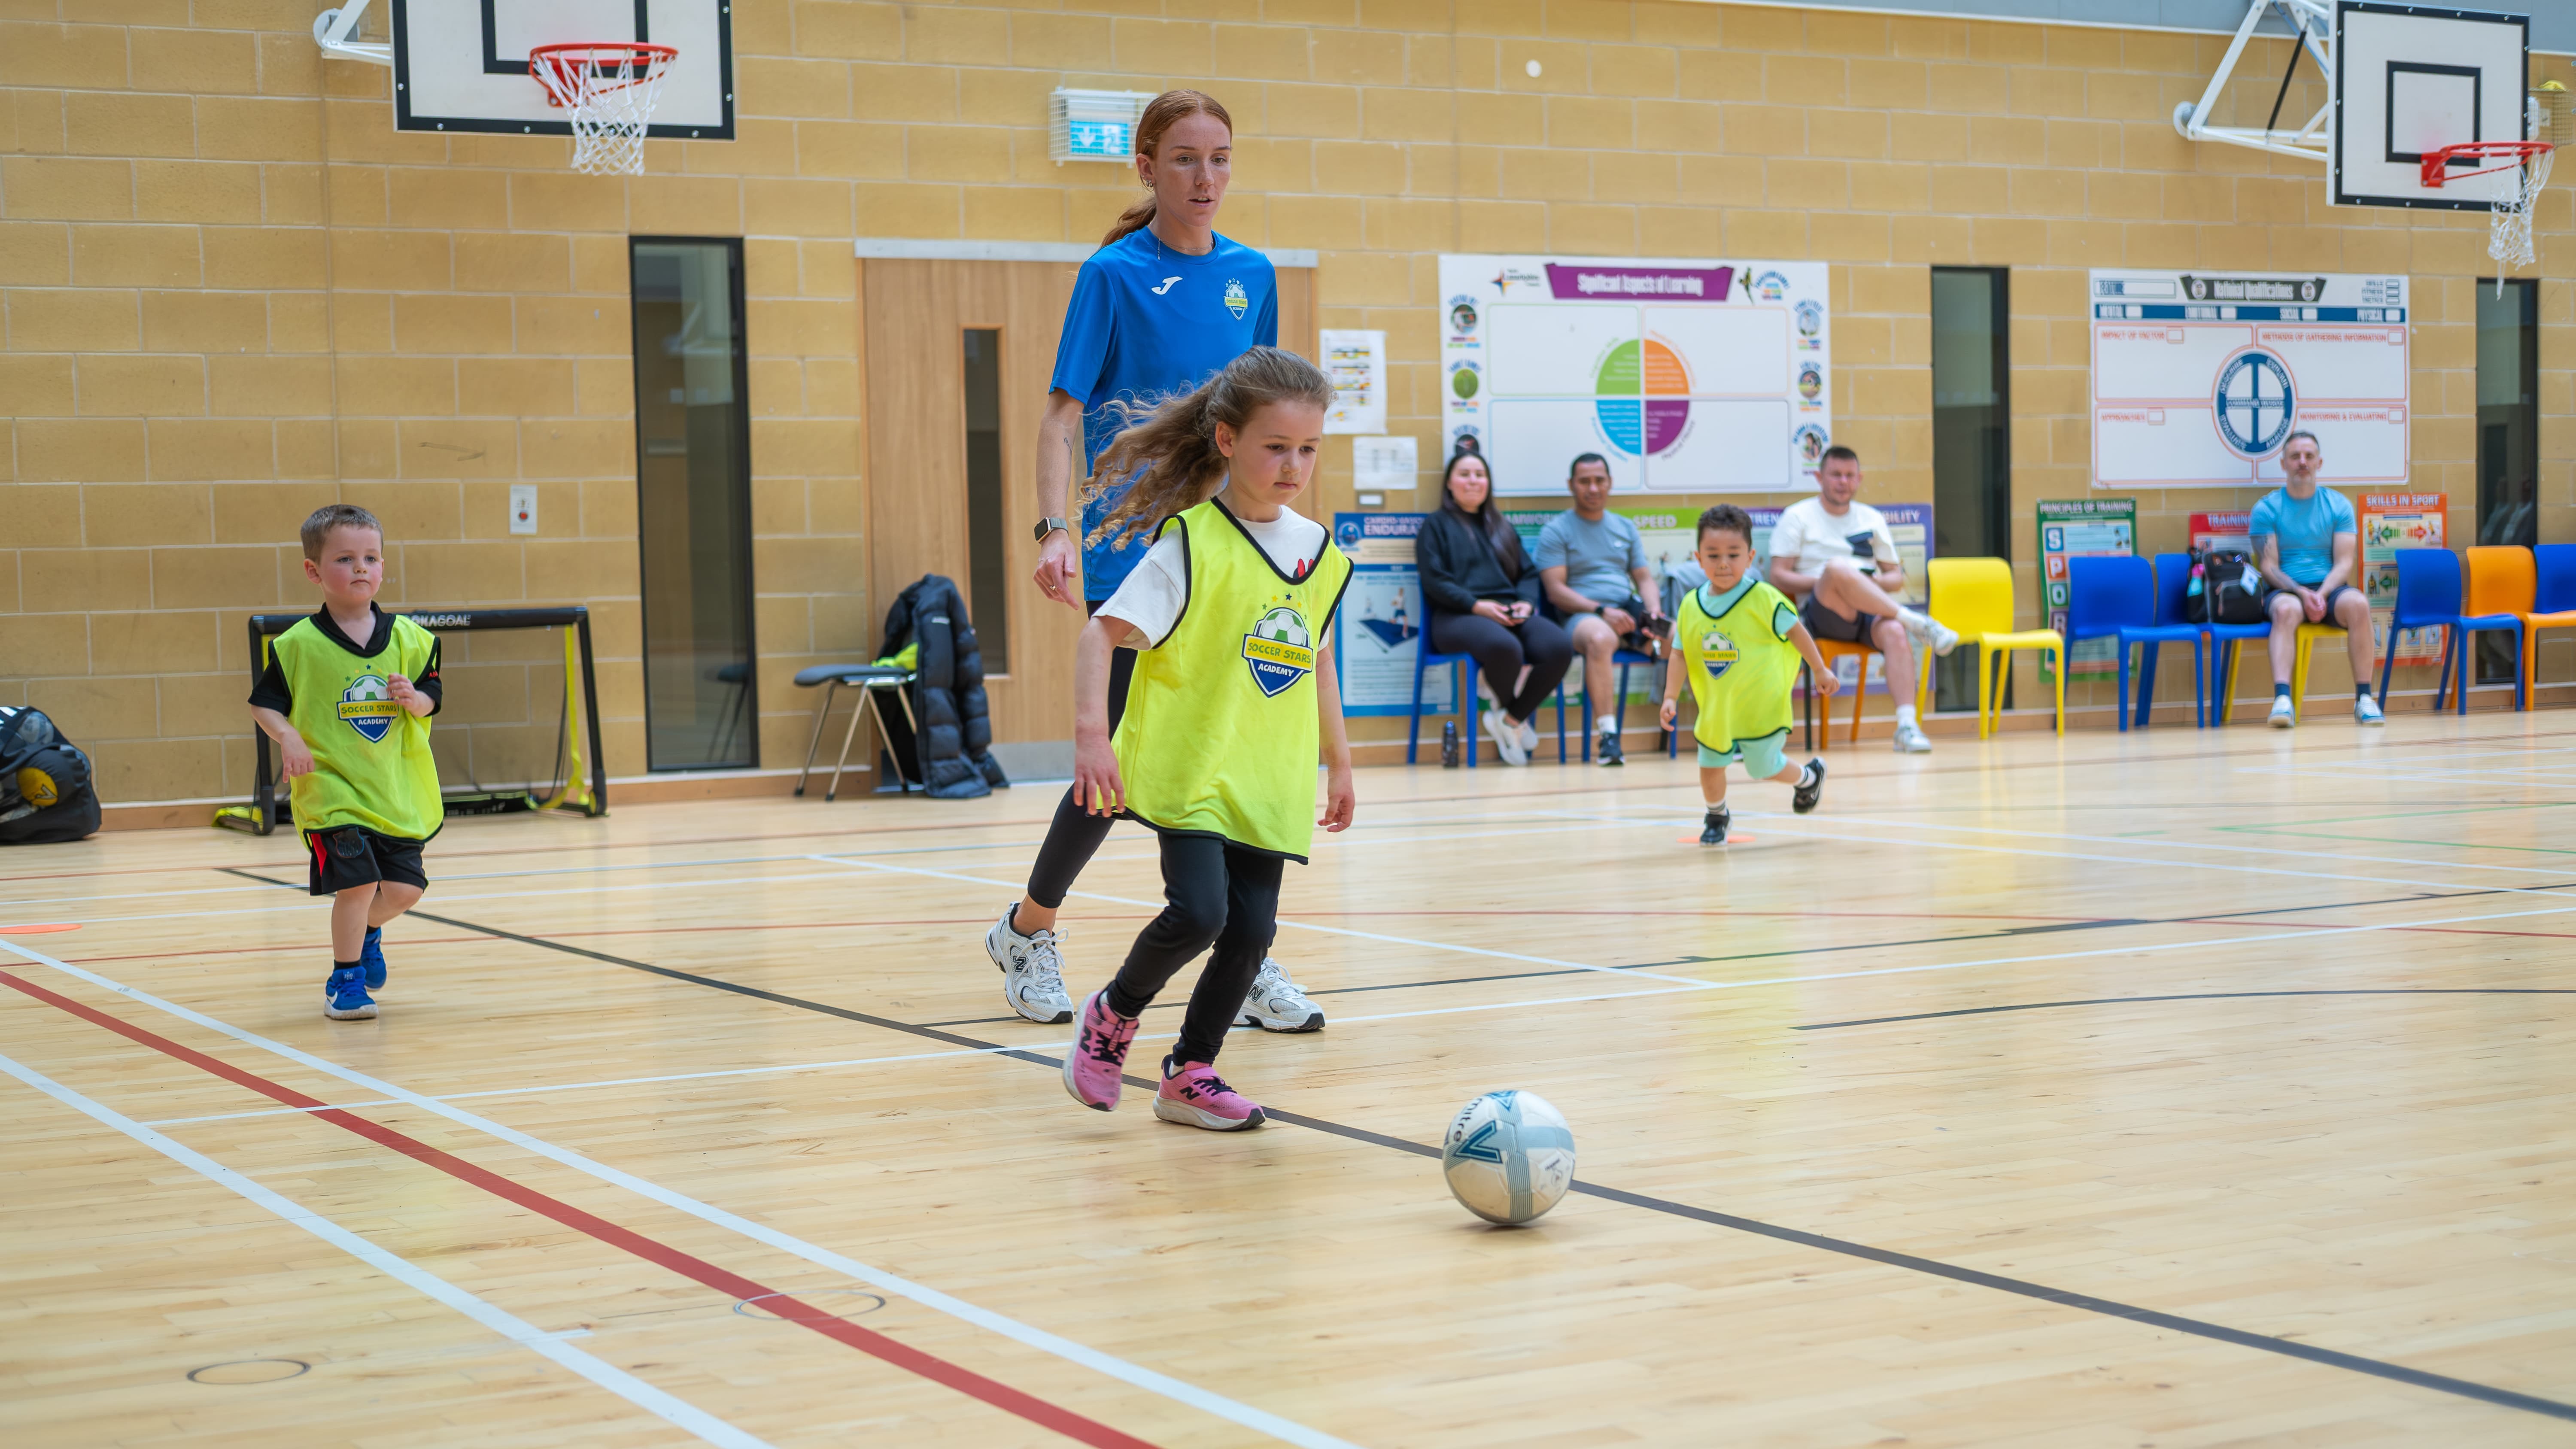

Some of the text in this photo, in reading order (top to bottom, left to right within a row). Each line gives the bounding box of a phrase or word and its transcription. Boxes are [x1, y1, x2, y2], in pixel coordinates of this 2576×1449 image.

[2040, 500, 2133, 514] PRINCIPLES OF TRAINING
[2366, 494, 2439, 507] SKILLS IN SPORT
[1633, 514, 1677, 529] SPEED
[2208, 514, 2249, 527] TRAININ
[1364, 524, 1419, 536] ENDURA
[2048, 529, 2062, 550] S
[2050, 557, 2063, 578] P
[2052, 584, 2066, 605] O
[410, 614, 471, 627] OKAGOAL
[1248, 642, 1311, 664] SOCCER STARS
[1258, 663, 1294, 677] ACADEMY
[341, 705, 374, 714] SOCCER
